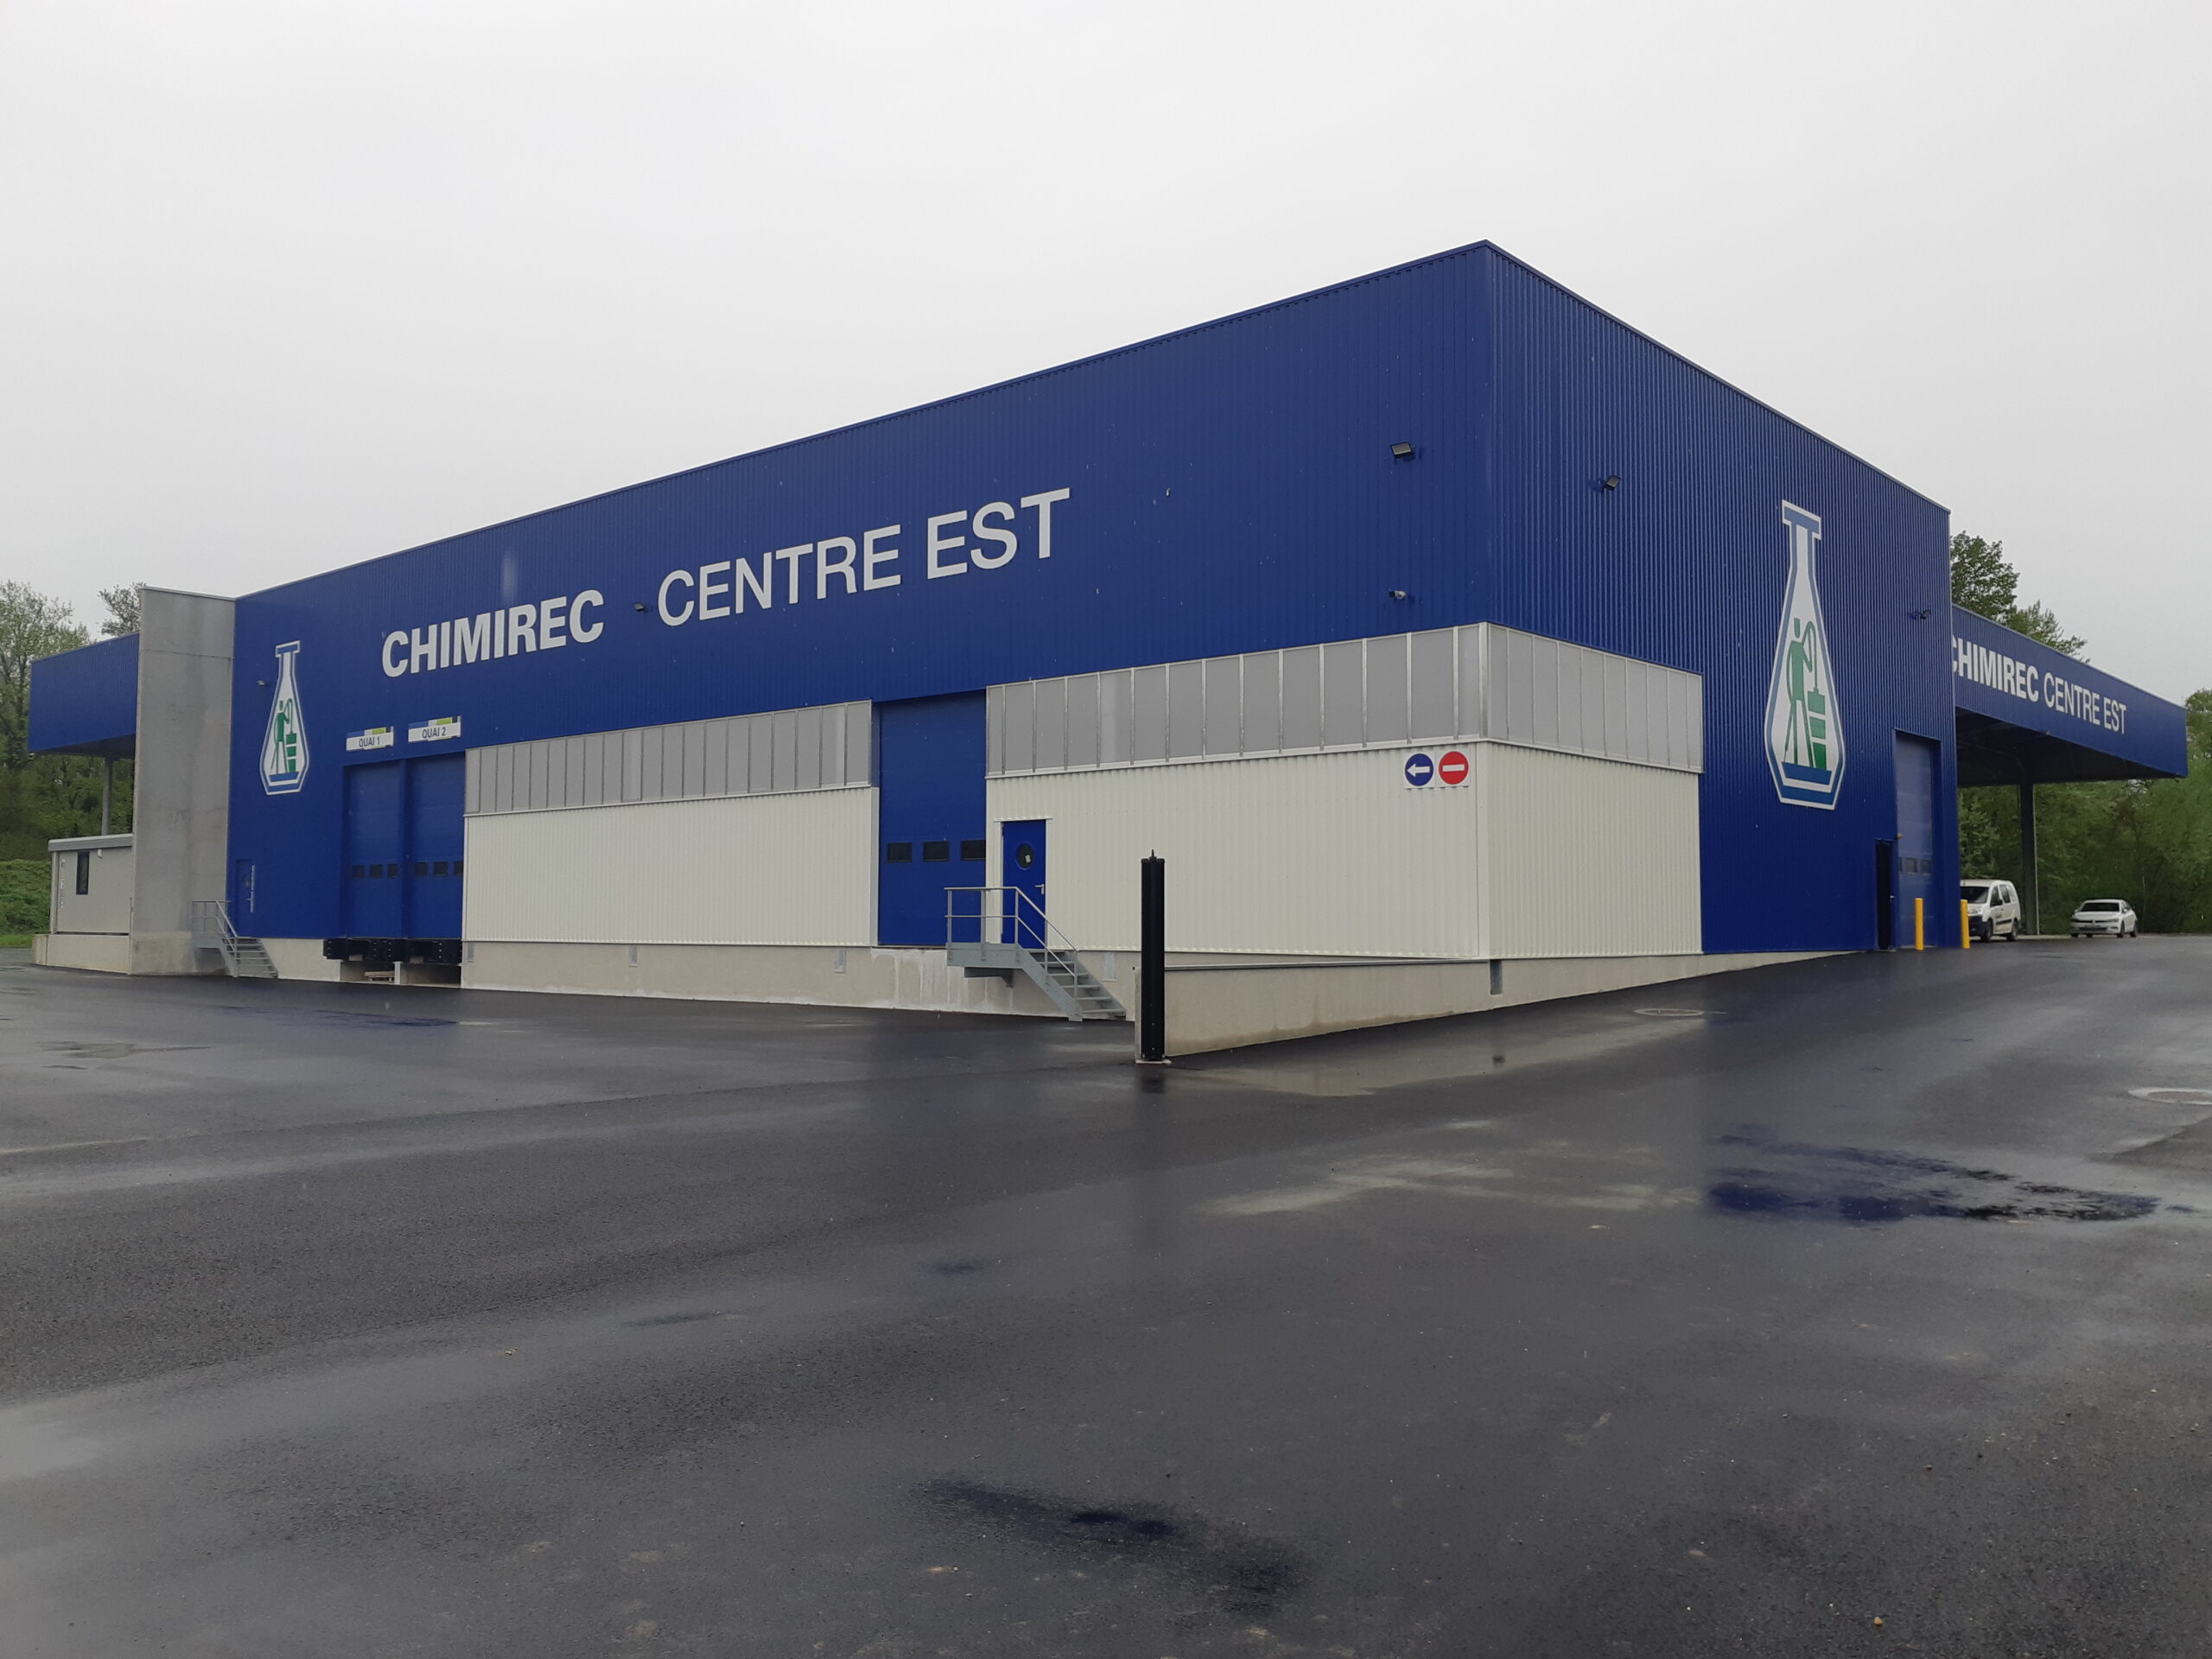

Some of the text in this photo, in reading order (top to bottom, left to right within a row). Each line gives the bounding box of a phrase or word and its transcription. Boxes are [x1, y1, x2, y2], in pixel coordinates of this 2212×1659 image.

[382, 486, 1071, 677] CHIMIREC CENTRE EST
[2044, 672, 2101, 726] CENTRE
[2103, 696, 2127, 734] EST
[359, 736, 380, 747] QUAI 1
[422, 727, 447, 739] QUAI 2
